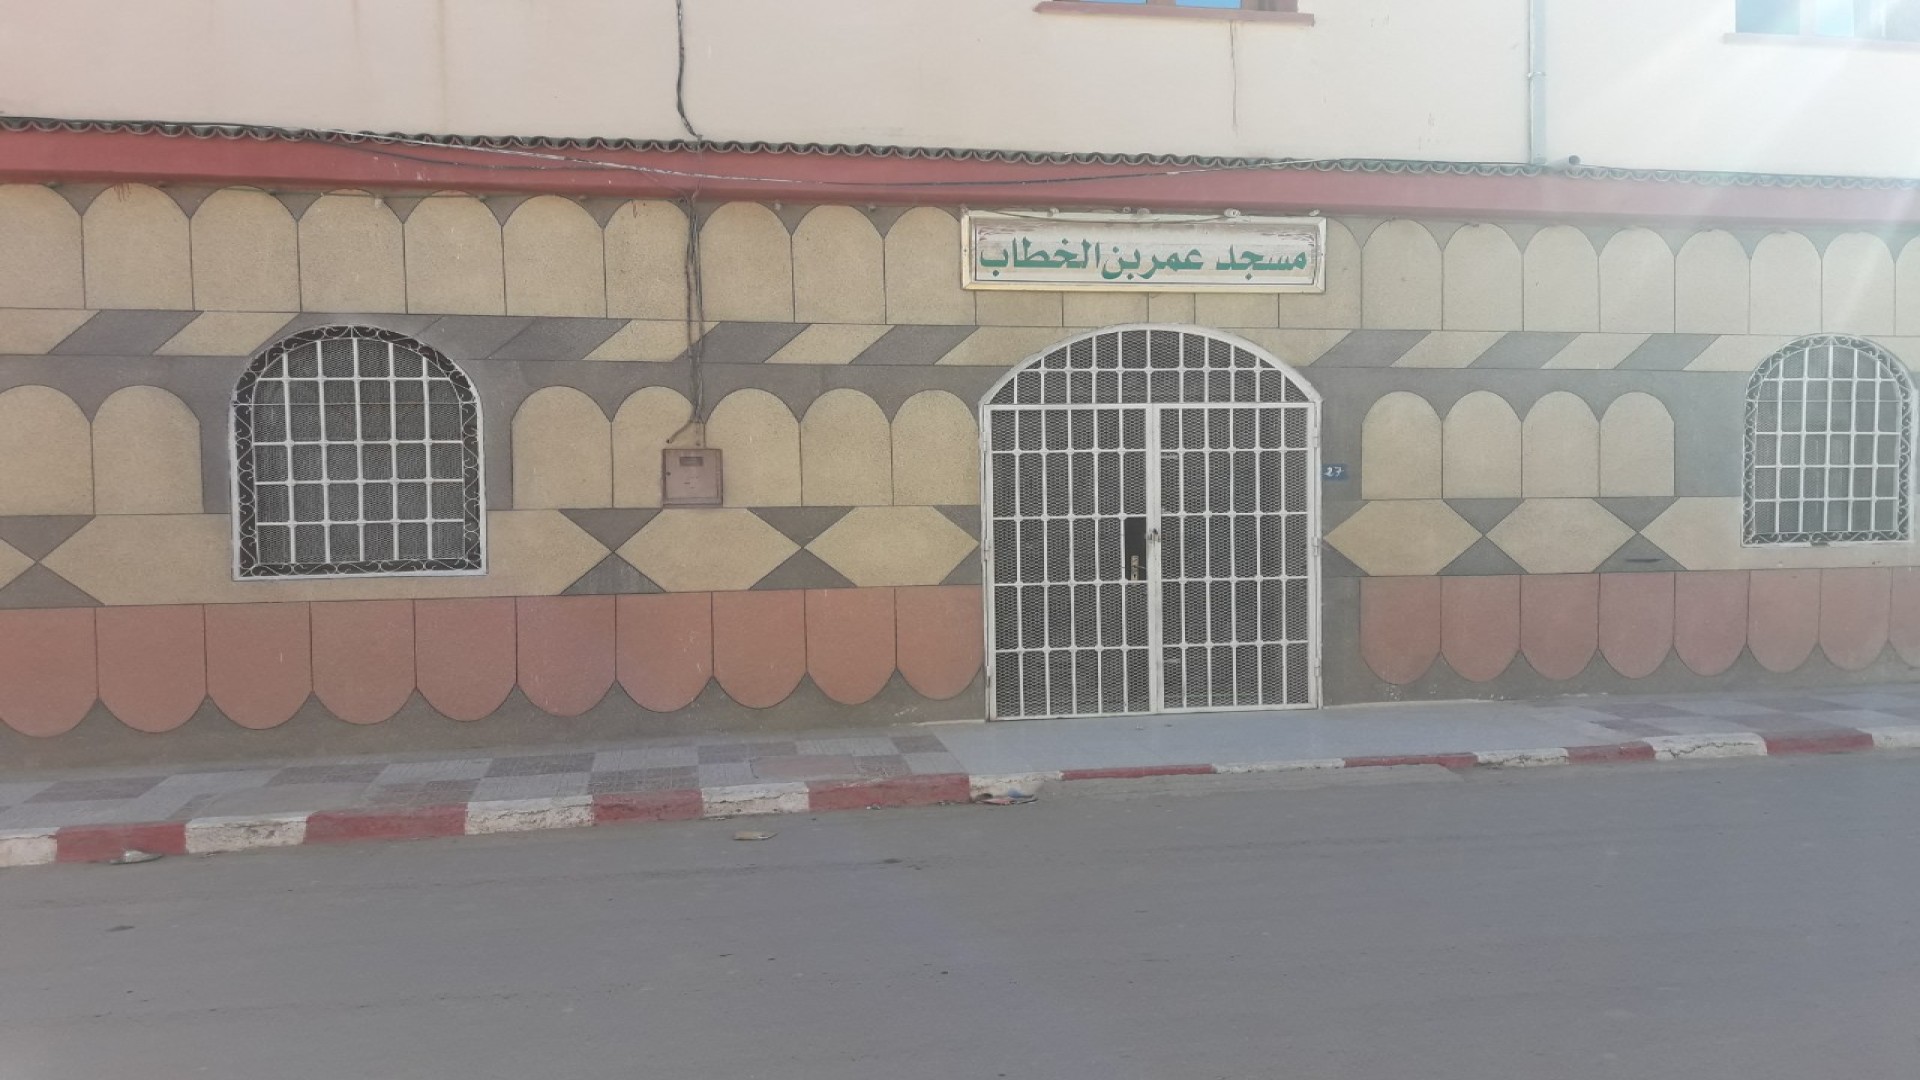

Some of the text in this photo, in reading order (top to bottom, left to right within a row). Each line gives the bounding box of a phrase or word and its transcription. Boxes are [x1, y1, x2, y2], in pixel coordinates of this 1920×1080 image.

[979, 236, 1307, 280] مسجد عمر بن الخطاب
[1325, 466, 1343, 477] 27
